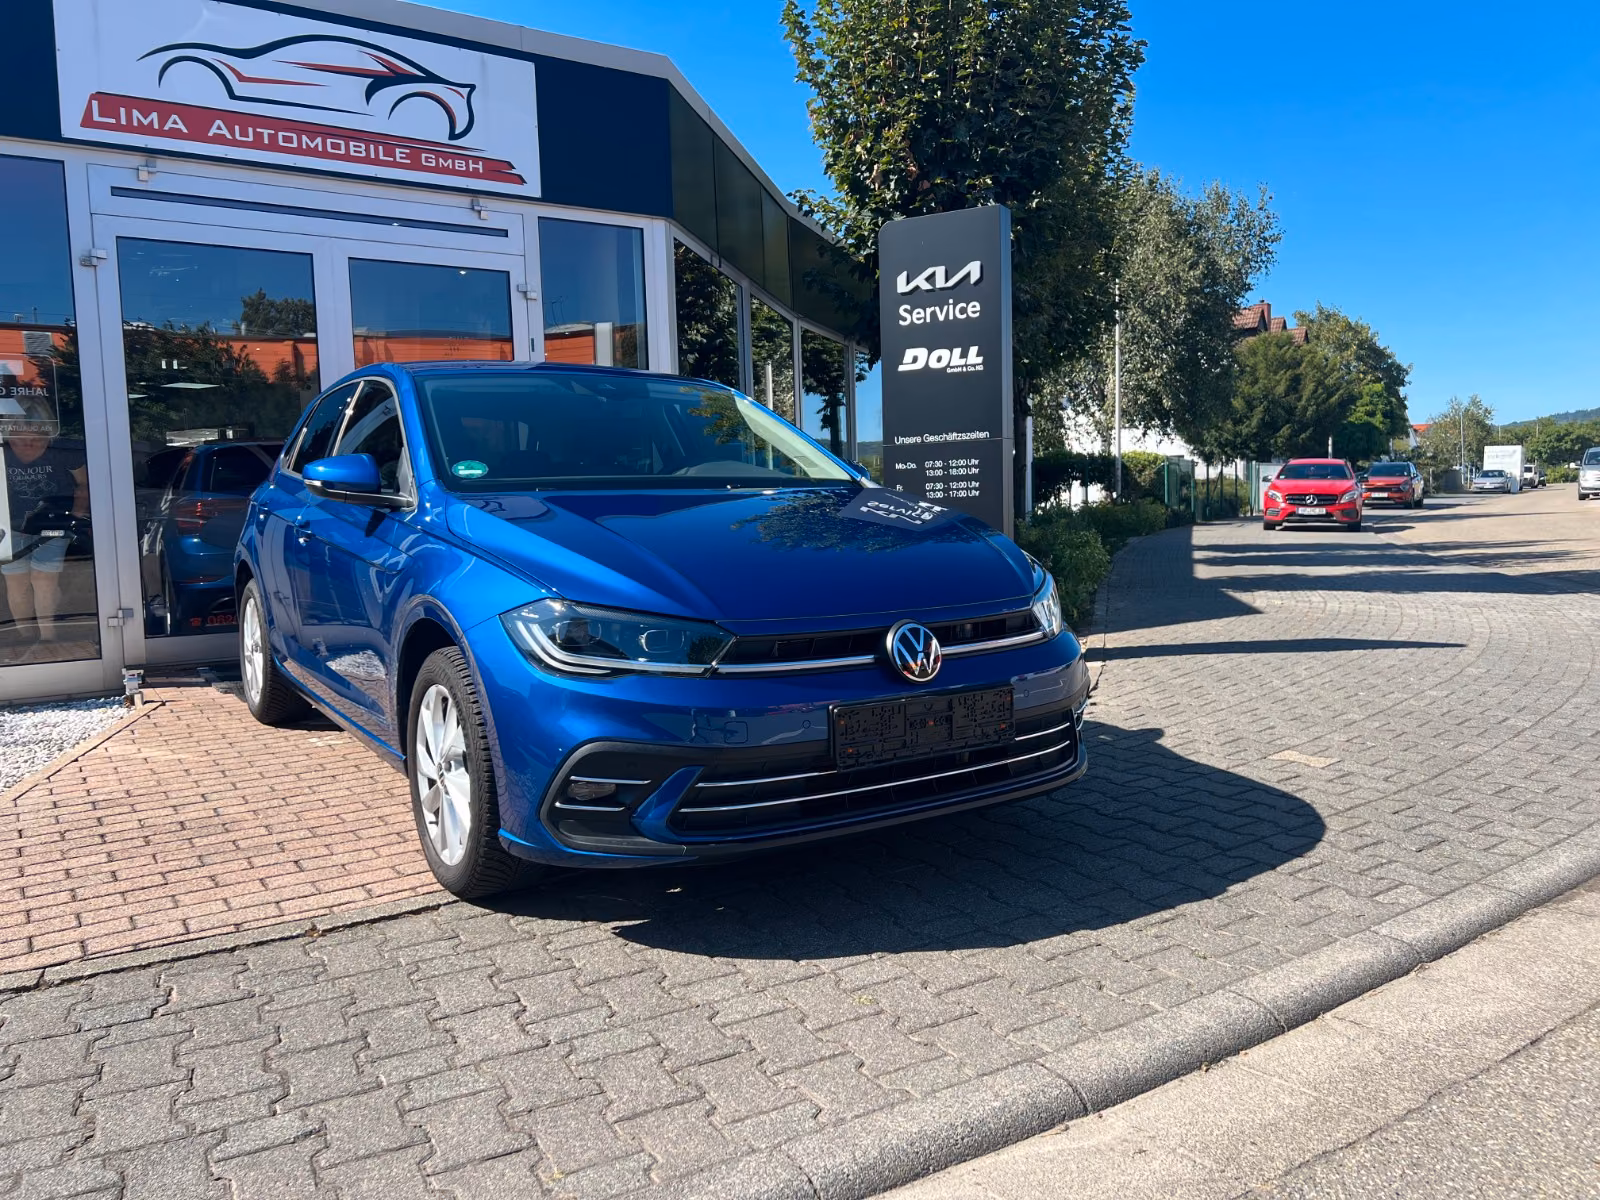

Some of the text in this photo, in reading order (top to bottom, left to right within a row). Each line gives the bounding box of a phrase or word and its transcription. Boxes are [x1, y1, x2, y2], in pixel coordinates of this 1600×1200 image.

[896, 260, 981, 293] KIA
[898, 298, 981, 326] Service
[897, 345, 984, 372] DOLL
[894, 436, 922, 445] Unsere
[924, 460, 943, 468] 07:30
[948, 459, 967, 467] 12:00
[967, 458, 980, 466] Uhr
[925, 469, 943, 477] 13:00
[949, 467, 967, 476] 18:00
[967, 467, 980, 475] Uhr
[925, 482, 944, 490] 07:30
[949, 481, 967, 489] 12:00
[968, 480, 980, 488] Uhr
[926, 491, 944, 499] 13:00
[949, 490, 967, 498] 17:00
[968, 489, 980, 497] Uhr
